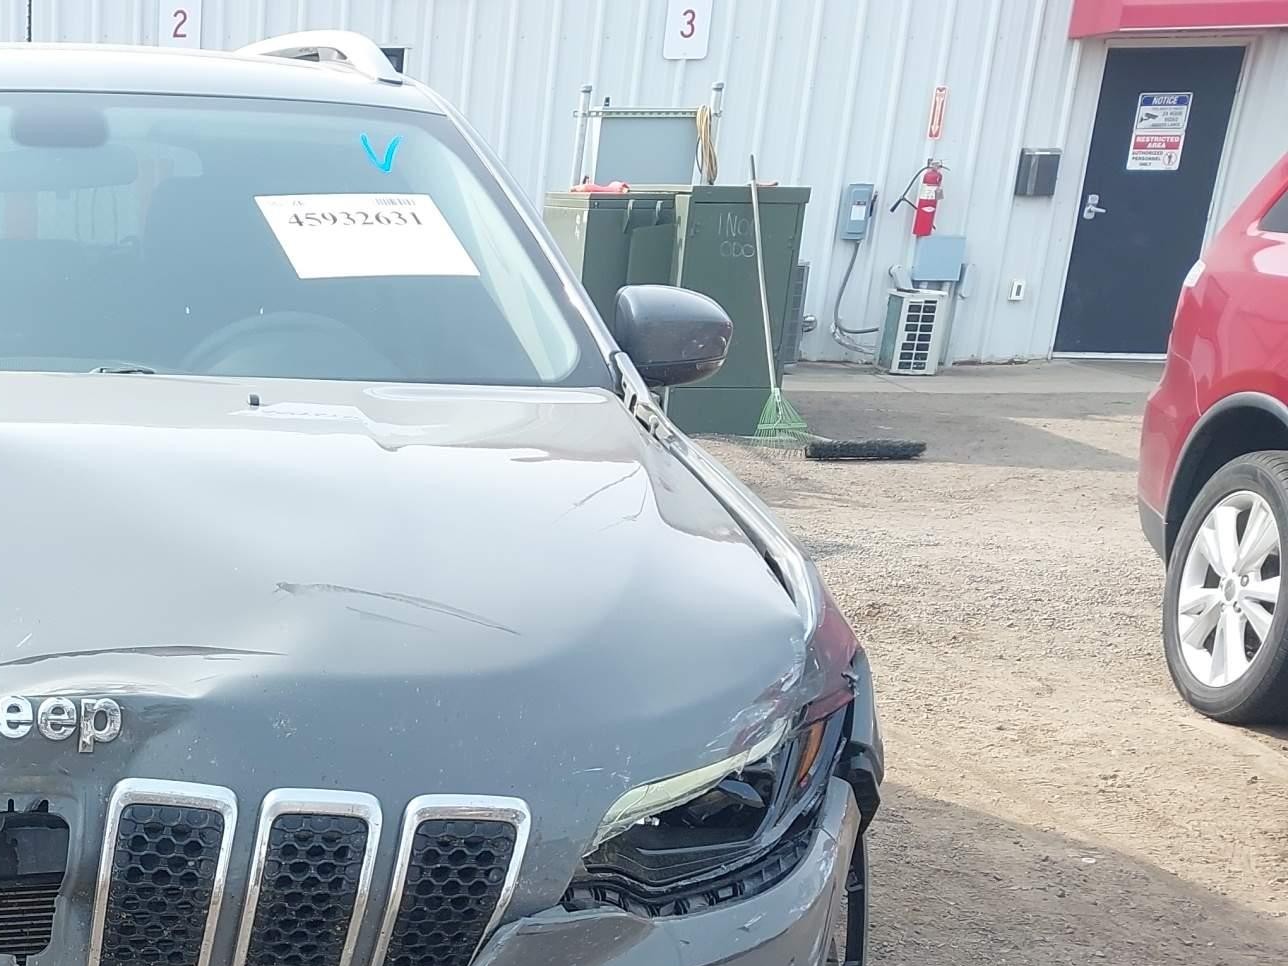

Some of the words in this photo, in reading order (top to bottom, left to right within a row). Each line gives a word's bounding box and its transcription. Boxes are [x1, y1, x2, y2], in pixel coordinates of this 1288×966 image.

[173, 9, 187, 38] 2
[680, 9, 696, 38] 3
[1152, 96, 1178, 105] NOTICE
[288, 211, 423, 227] 45932631
